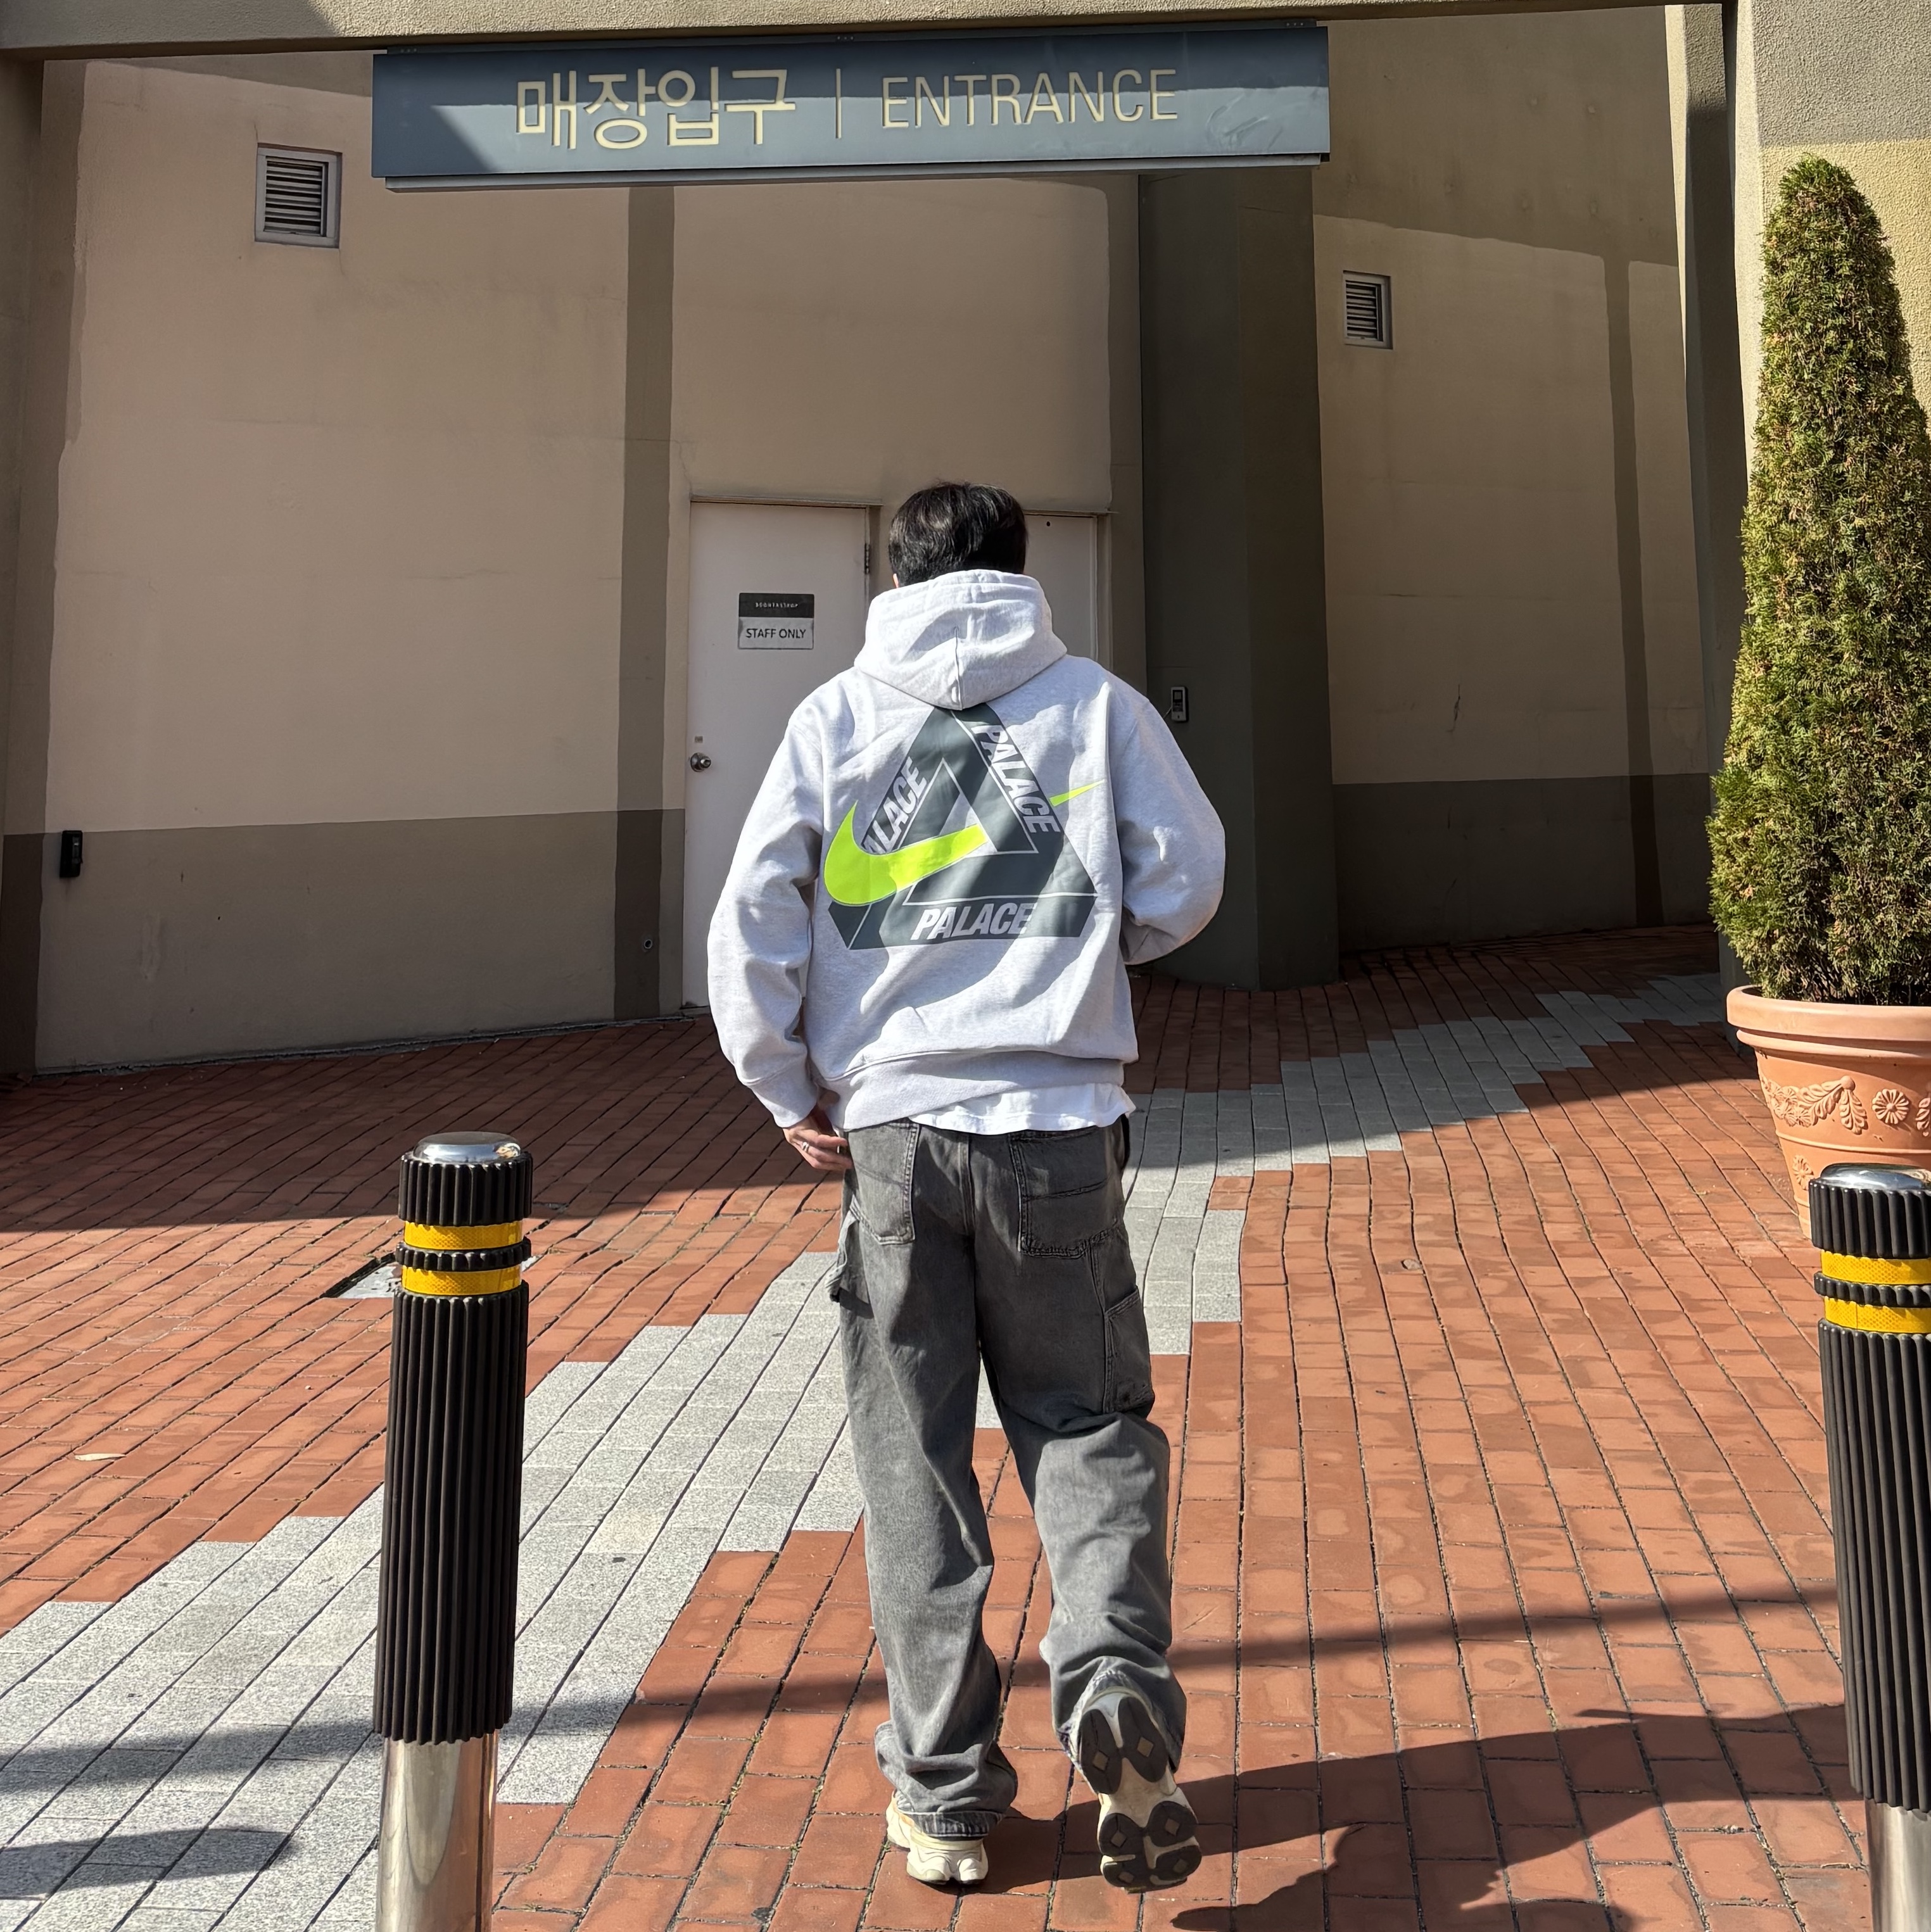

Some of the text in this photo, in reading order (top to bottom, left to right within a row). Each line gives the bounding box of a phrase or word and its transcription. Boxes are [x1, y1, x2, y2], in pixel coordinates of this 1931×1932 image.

[516, 66, 796, 149] 매장입구
[882, 68, 1179, 129] ENTRANCE
[746, 628, 806, 639] STAFF ONLY
[863, 756, 928, 855] ALACE
[971, 724, 1061, 834] PALACE
[910, 902, 1037, 941] PALACE
